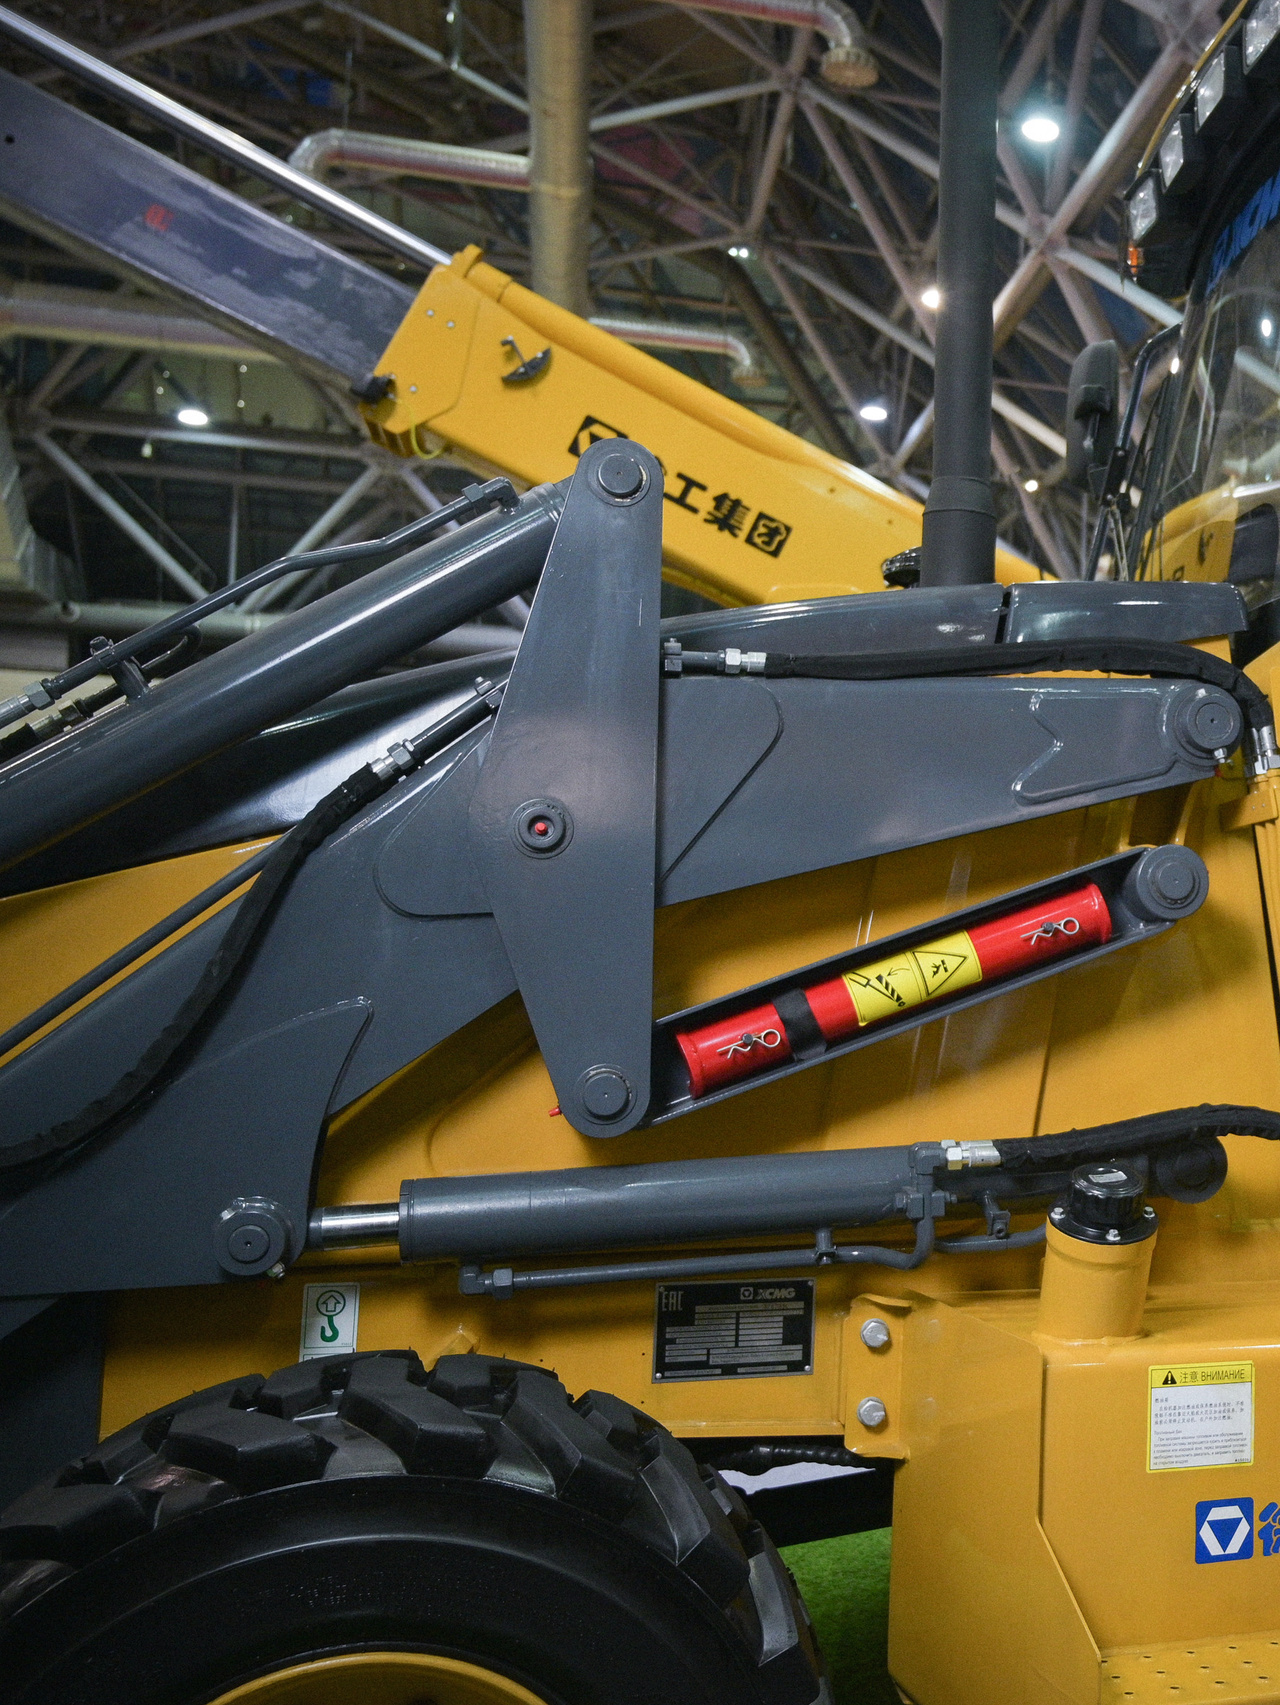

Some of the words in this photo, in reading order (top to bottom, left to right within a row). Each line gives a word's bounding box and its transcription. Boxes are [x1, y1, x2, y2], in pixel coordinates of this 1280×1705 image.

[655, 455, 793, 559] 工集团
[756, 1287, 796, 1300] XCMG
[1180, 1371, 1199, 1383] 注意
[1201, 1368, 1246, 1382] ВНИМАНИЕ
